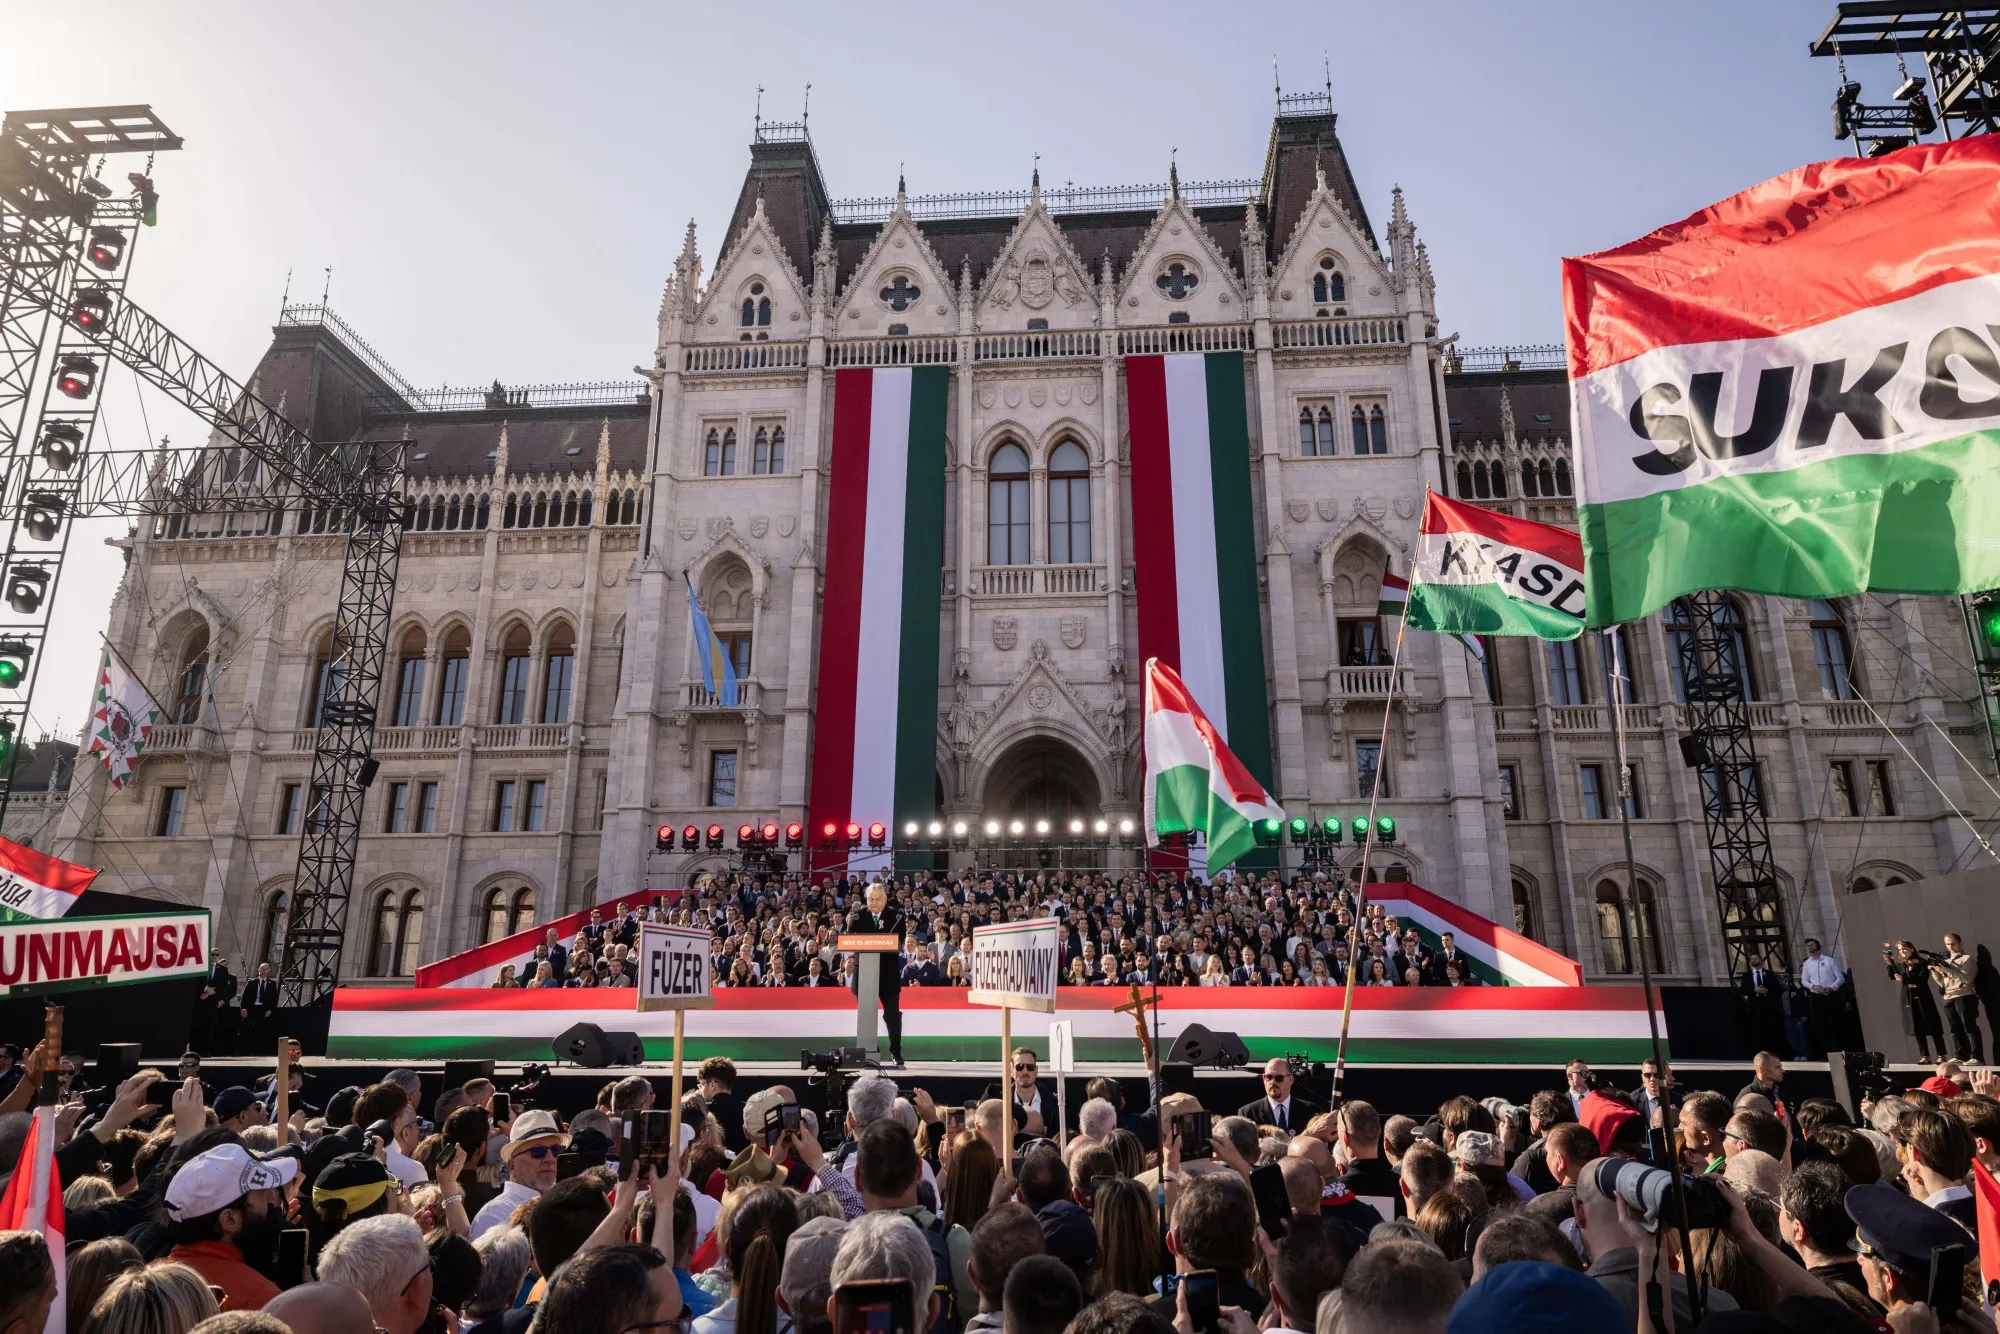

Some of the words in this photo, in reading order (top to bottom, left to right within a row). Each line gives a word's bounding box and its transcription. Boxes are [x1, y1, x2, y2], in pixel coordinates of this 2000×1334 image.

[1629, 324, 2000, 476] SUKO
[0, 924, 203, 986] UNMAJSA
[650, 940, 702, 995] FÜZÉR
[976, 935, 1054, 995] FÜZÉRRADVÁNY
[250, 1169, 268, 1187] H
